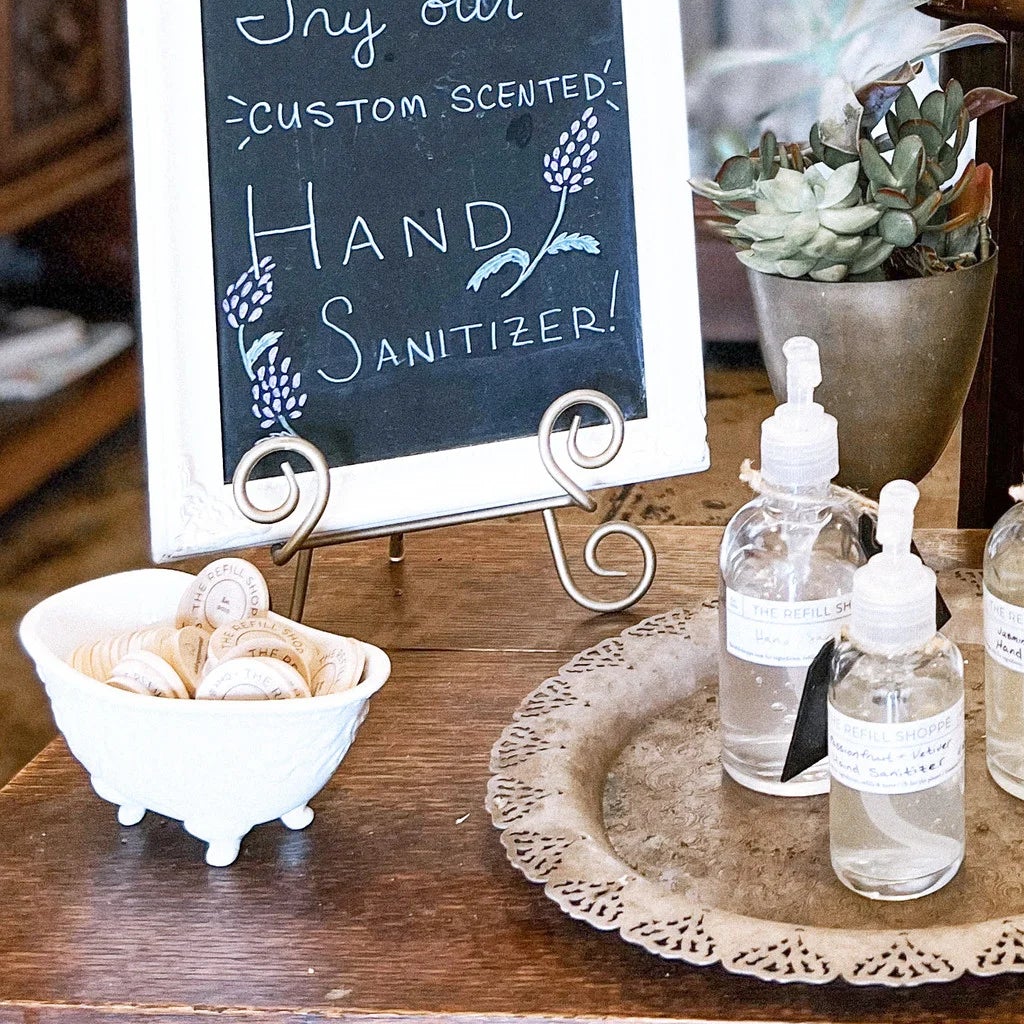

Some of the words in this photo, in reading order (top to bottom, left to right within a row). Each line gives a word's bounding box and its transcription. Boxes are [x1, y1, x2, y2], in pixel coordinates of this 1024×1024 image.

[249, 92, 428, 135] CUSTOM
[451, 72, 606, 114] SCENTED
[247, 182, 513, 279] HAND
[318, 270, 620, 383] SANITIZER!
[751, 604, 777, 619] THE
[783, 606, 831, 619] REFILL
[994, 639, 1023, 660] Hand
[843, 723, 890, 743] REFILL
[895, 716, 951, 742] SHOPPE
